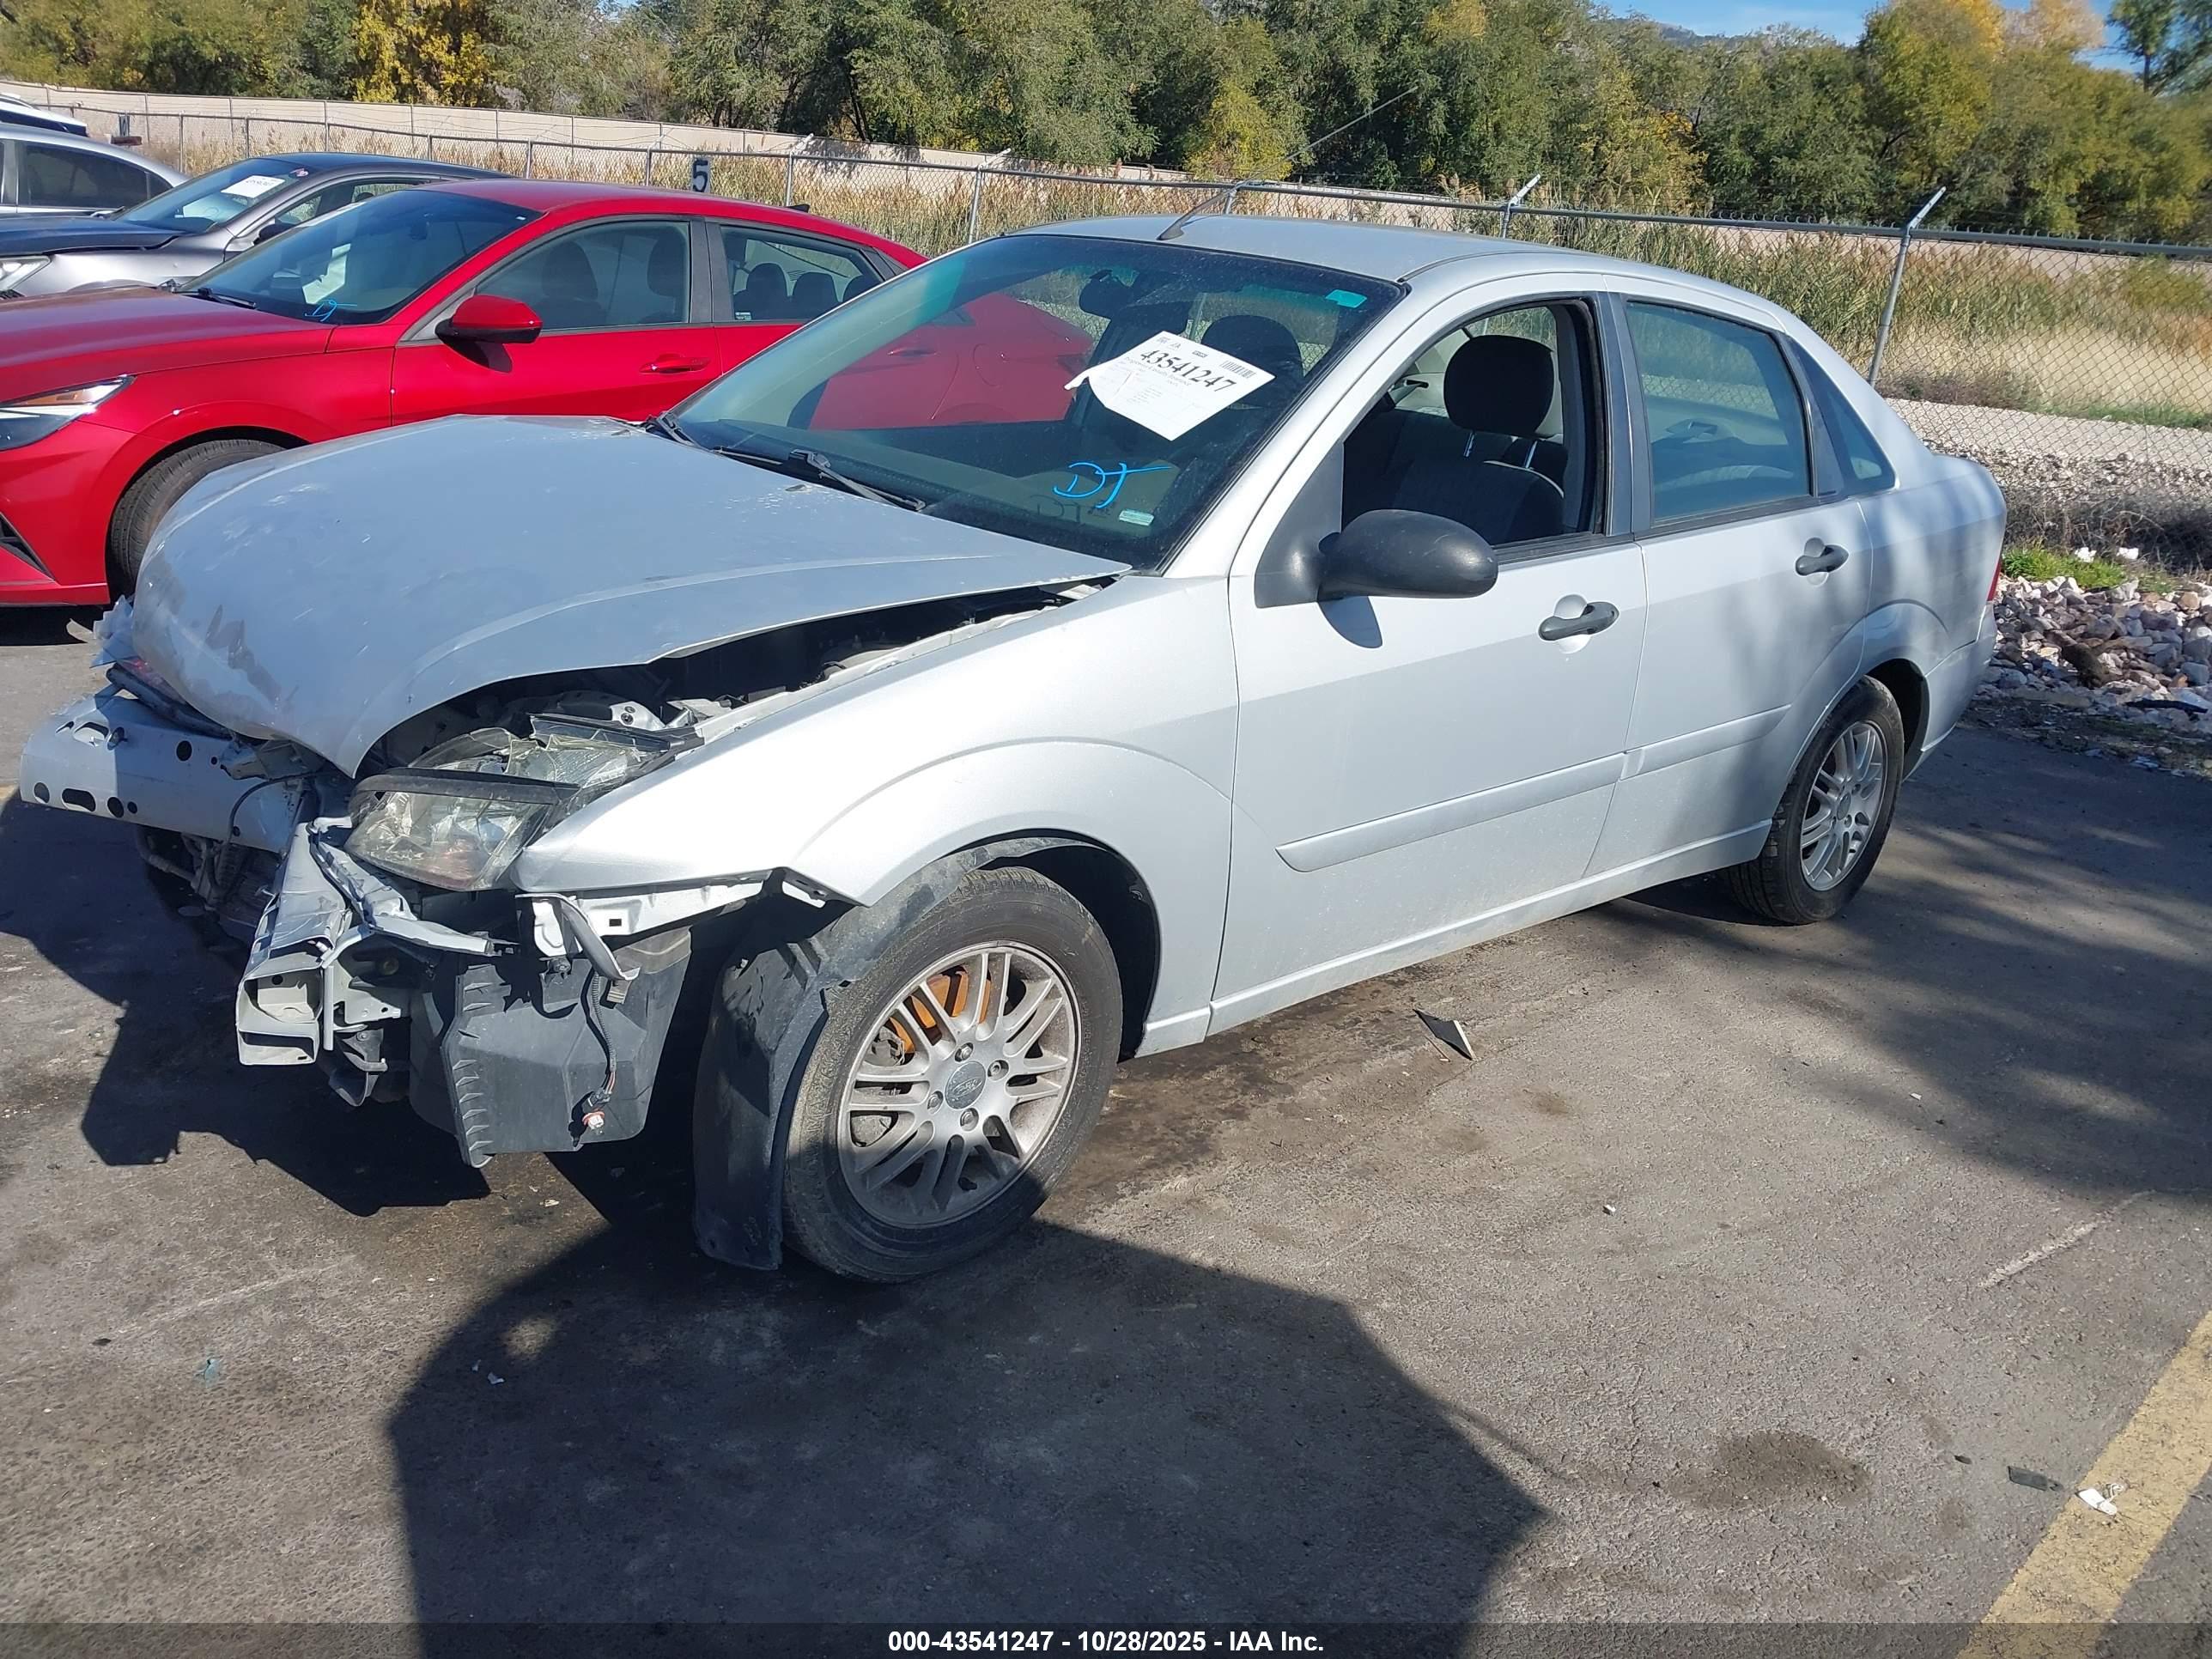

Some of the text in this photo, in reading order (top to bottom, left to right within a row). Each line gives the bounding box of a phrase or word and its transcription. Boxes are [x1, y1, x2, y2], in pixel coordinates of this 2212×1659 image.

[692, 159, 708, 193] 5
[1139, 349, 1237, 392] 43541247
[1052, 461, 1171, 509] DT
